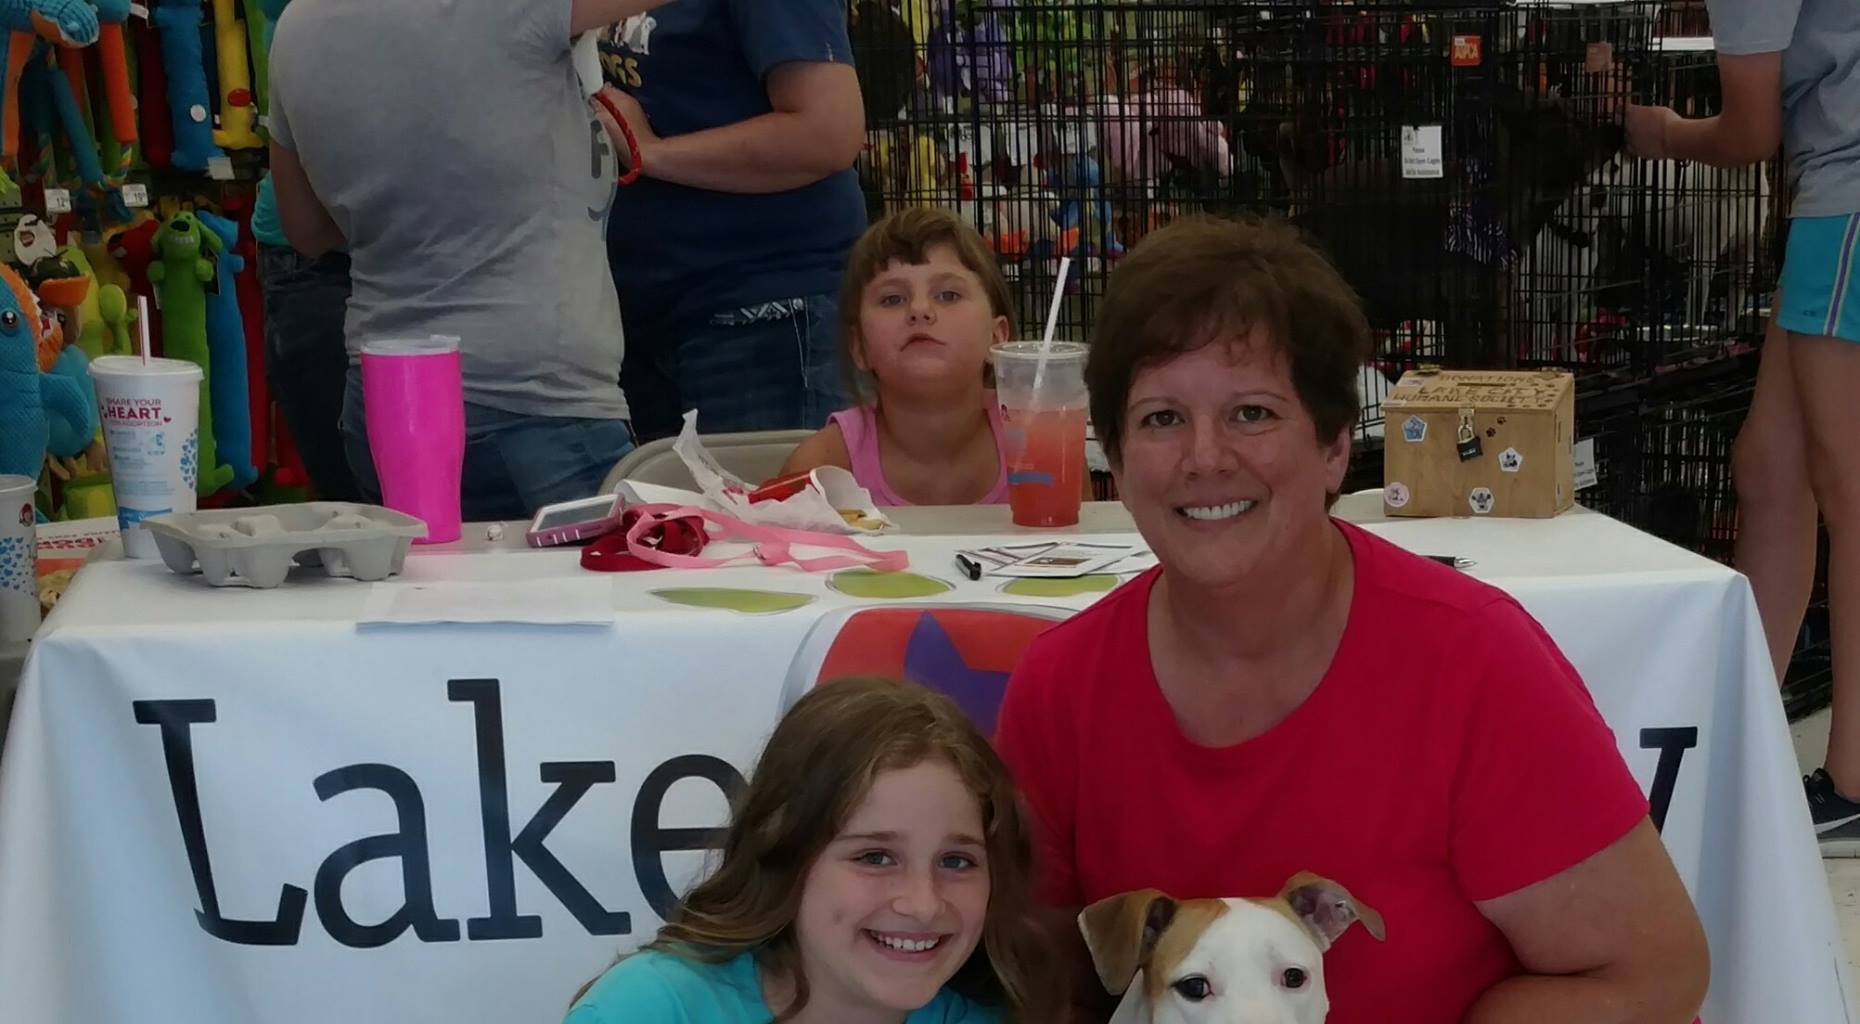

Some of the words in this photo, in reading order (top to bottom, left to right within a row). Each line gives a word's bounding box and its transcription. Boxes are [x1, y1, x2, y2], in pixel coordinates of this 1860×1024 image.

[106, 398, 131, 406] SHARE
[133, 398, 162, 406] YOUR
[107, 407, 162, 420] HEART
[132, 678, 745, 949] Lake
